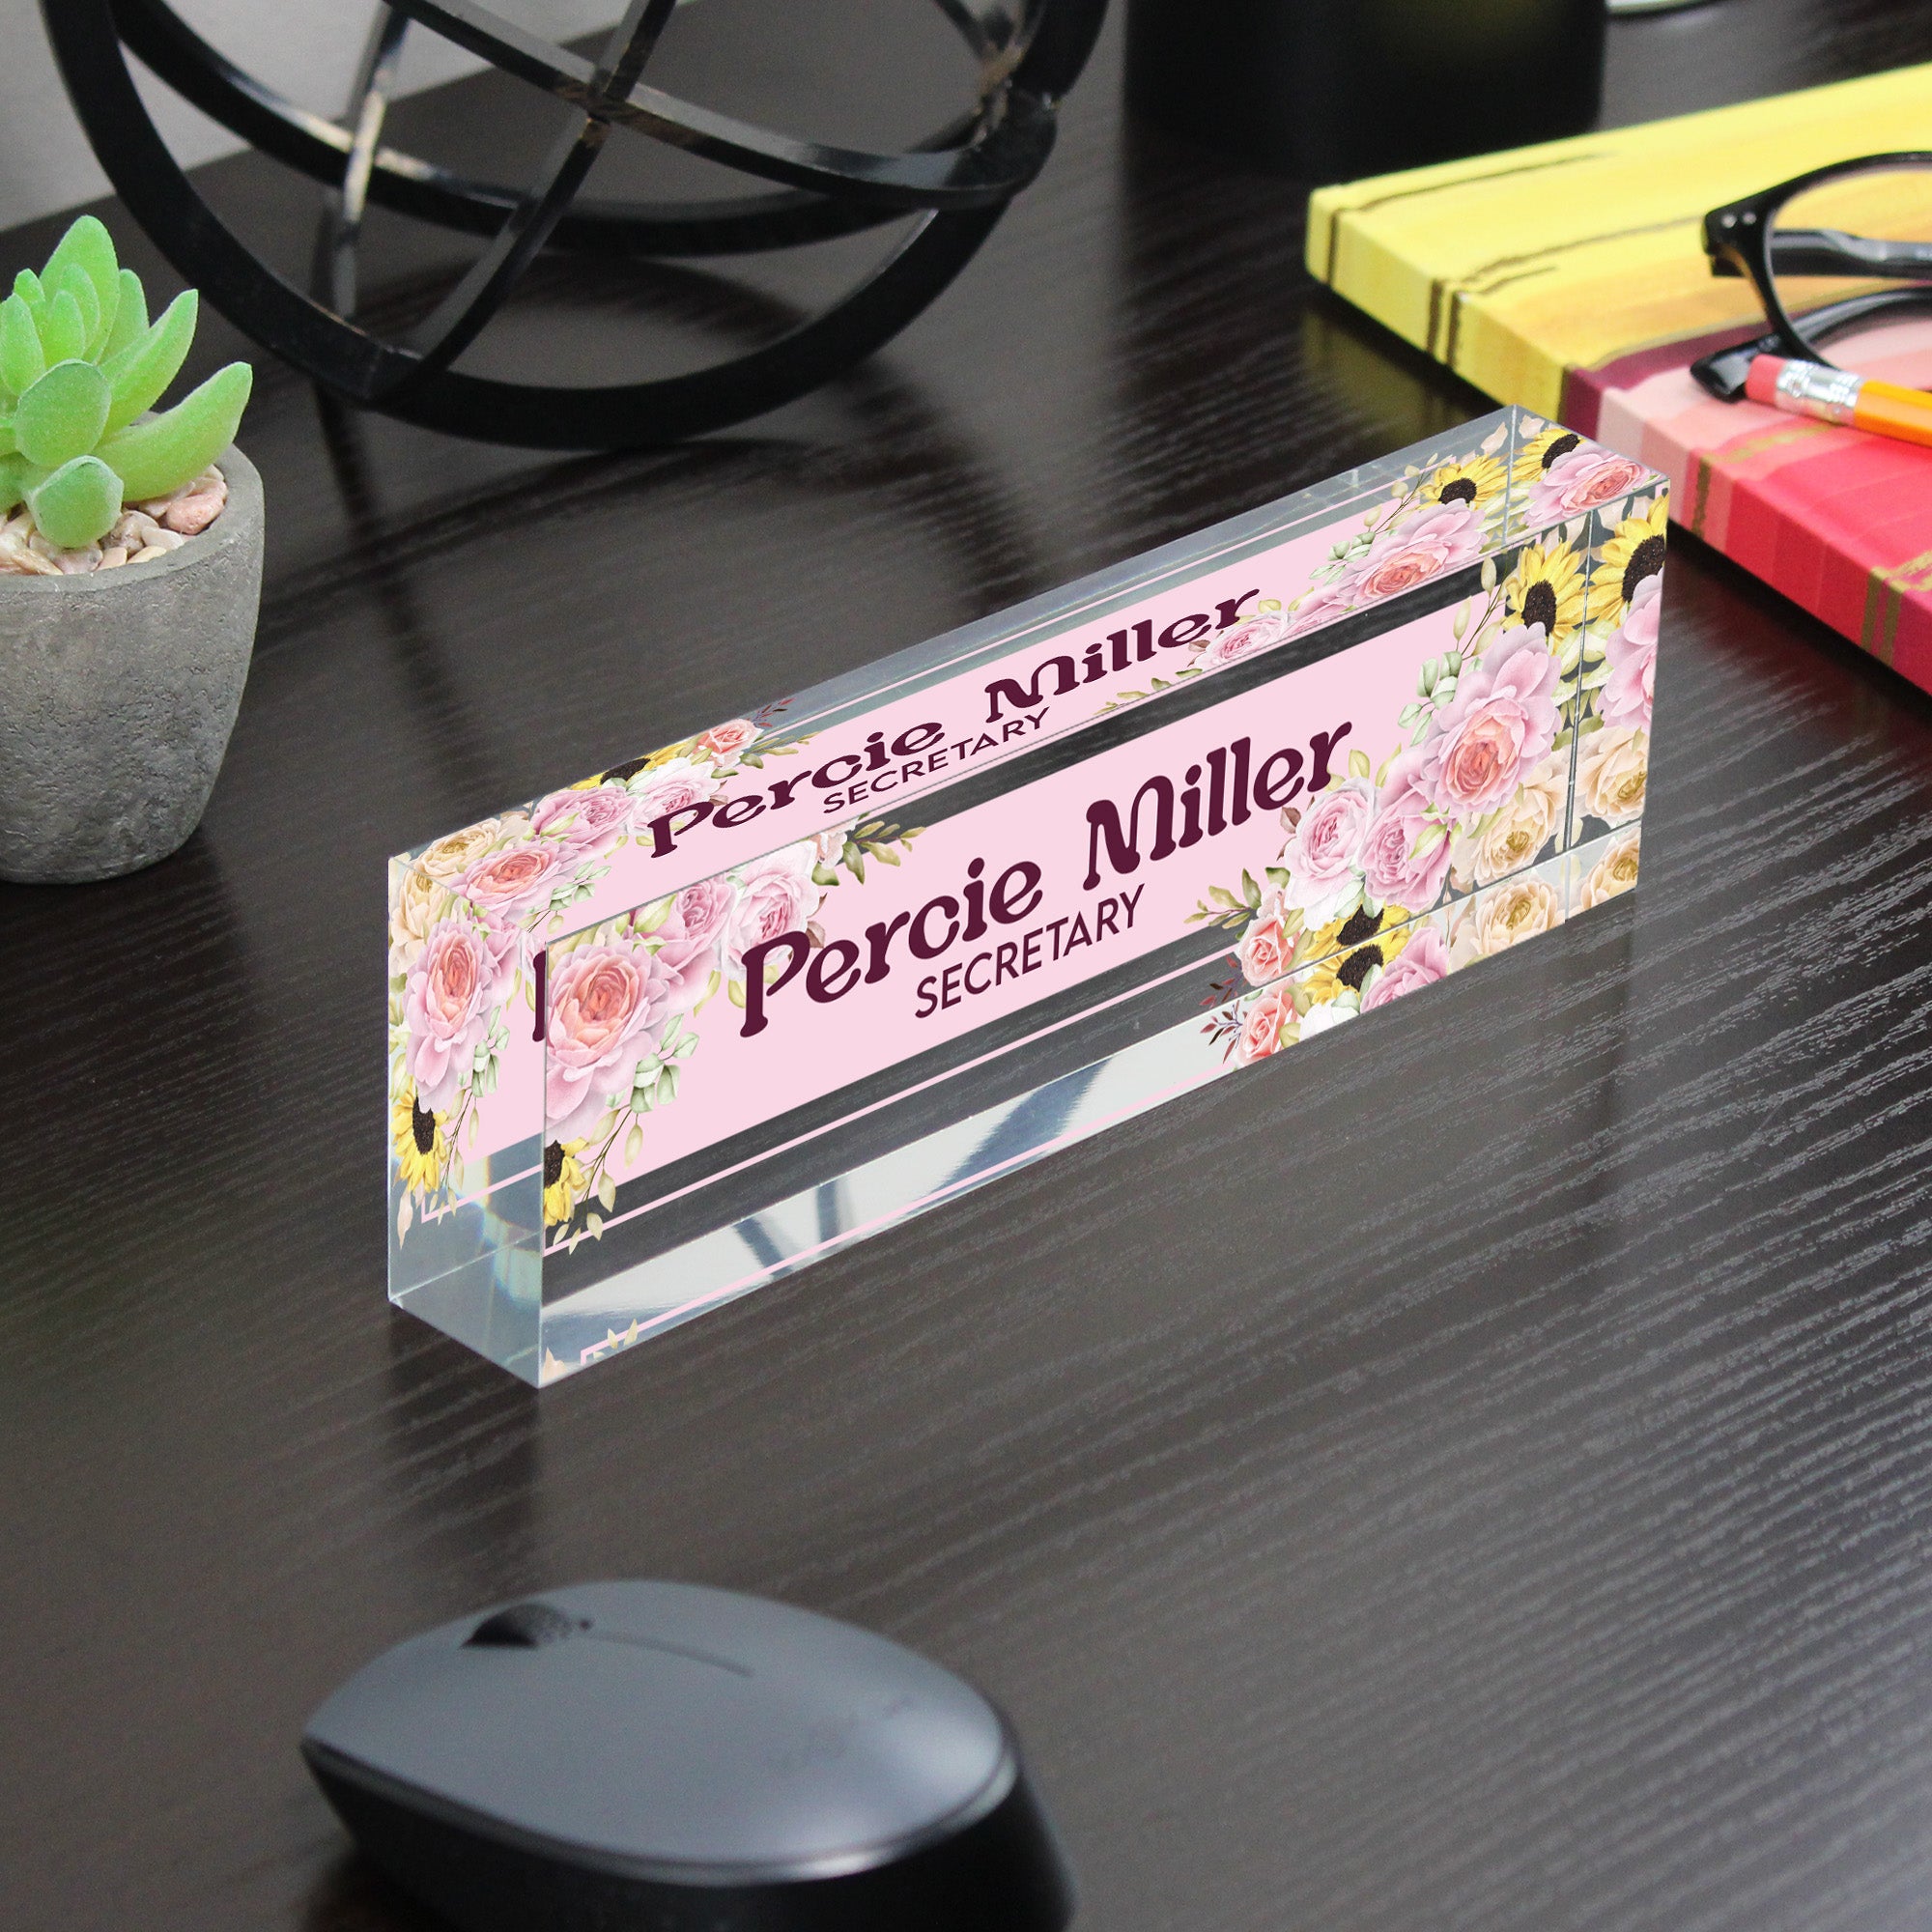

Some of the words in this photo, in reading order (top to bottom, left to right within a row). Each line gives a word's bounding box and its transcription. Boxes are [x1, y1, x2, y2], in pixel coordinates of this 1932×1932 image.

[647, 723, 946, 859] Percie
[984, 589, 1261, 724] Miller
[823, 706, 1050, 814] SECRETARY
[739, 857, 1043, 1038] Percie
[1082, 721, 1352, 892] Miller
[914, 883, 1146, 1019] SECRETARY
